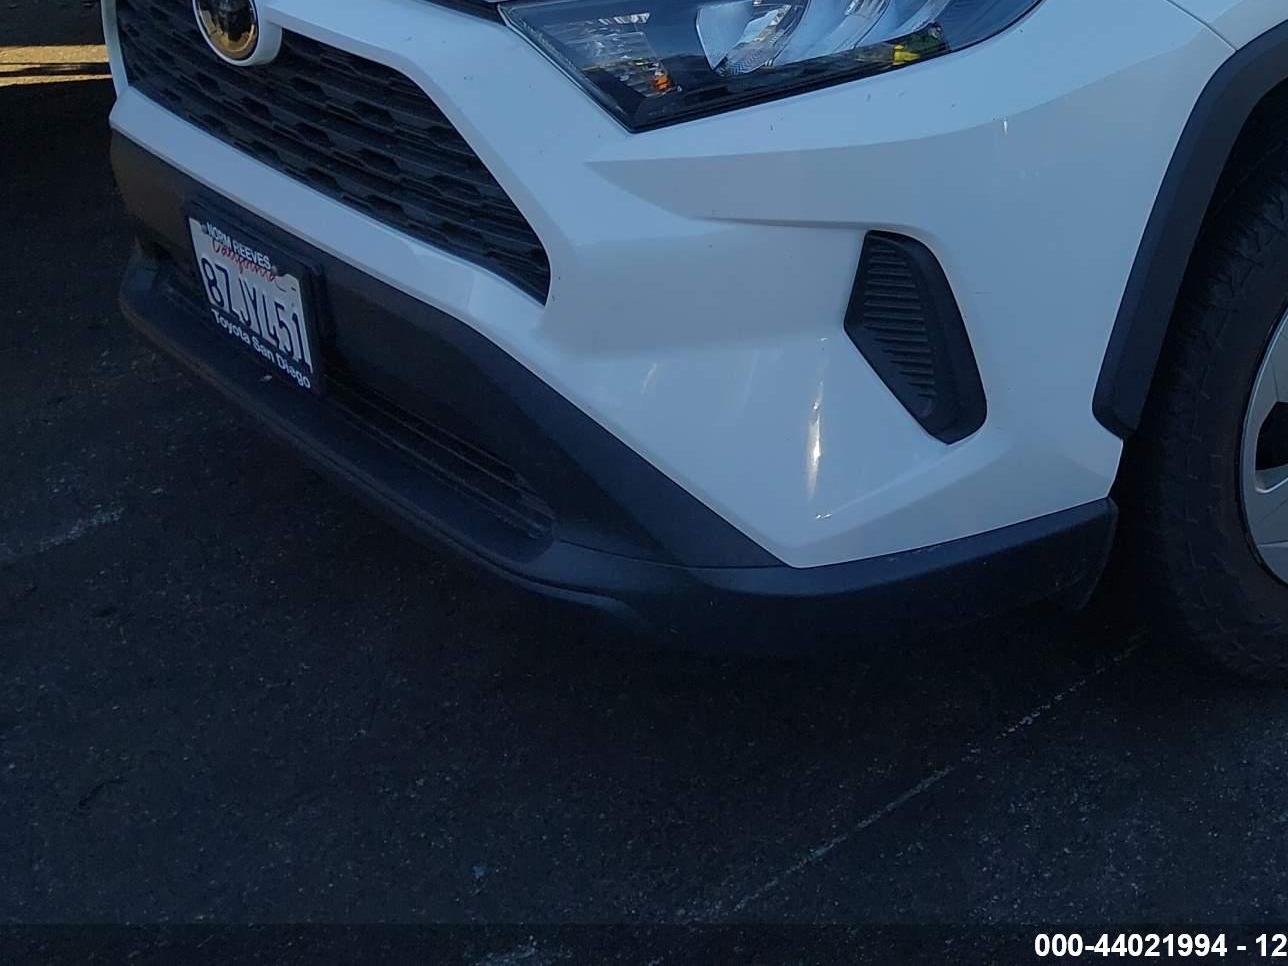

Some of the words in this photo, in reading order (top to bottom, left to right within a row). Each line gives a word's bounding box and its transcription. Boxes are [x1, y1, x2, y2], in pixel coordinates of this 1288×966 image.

[233, 240, 272, 270] REEVES
[211, 308, 252, 347] Toyota
[251, 335, 276, 364] San
[276, 350, 312, 389] Diego
